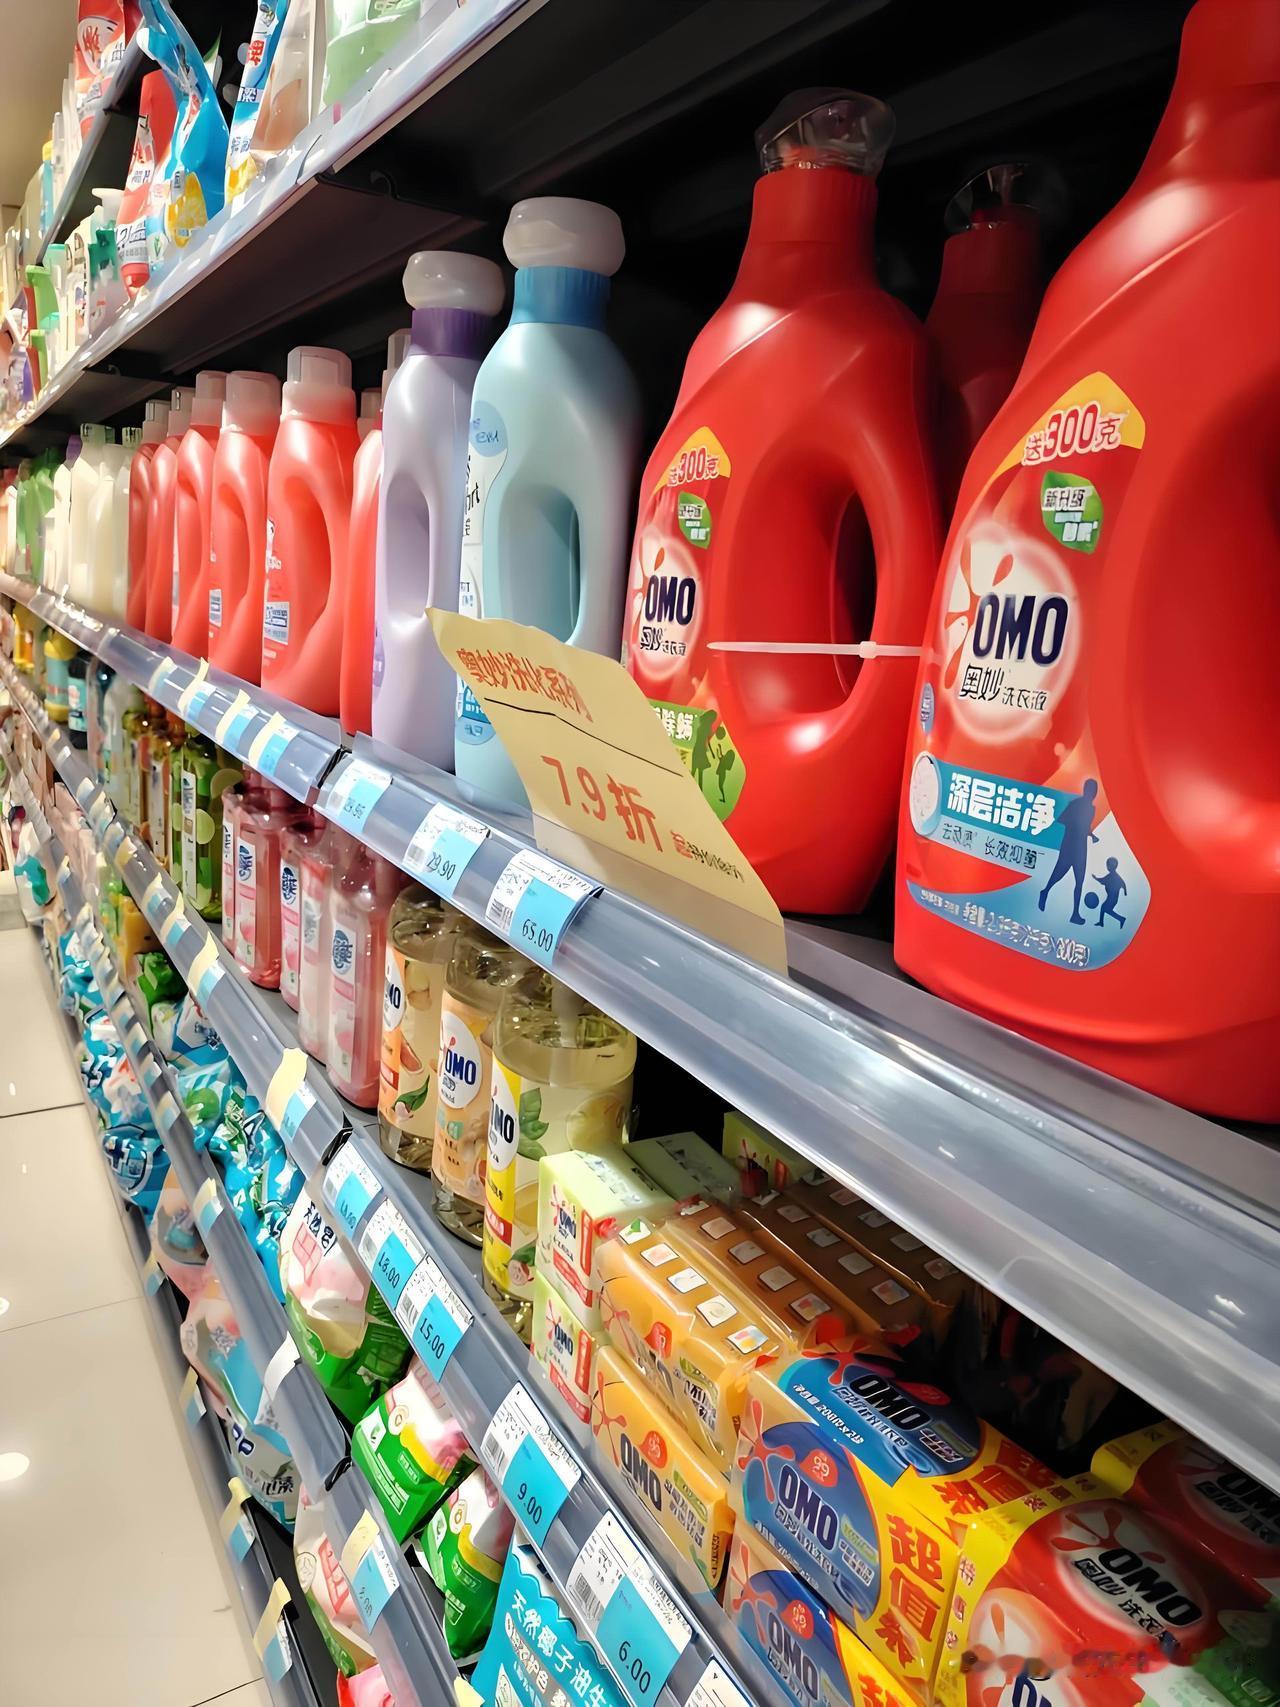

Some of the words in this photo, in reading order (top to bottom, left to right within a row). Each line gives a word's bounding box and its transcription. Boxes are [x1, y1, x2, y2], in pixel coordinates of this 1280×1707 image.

[644, 573, 697, 626] OMO
[972, 592, 1069, 667] OMO
[946, 772, 1057, 837] 深层洁净
[426, 851, 457, 881] 29.90
[521, 918, 554, 953] 65.00
[444, 1047, 477, 1086] OMO
[490, 1098, 516, 1144] MO
[419, 1317, 446, 1360] 15.00
[850, 1374, 932, 1431] OMO
[516, 1482, 543, 1525] 9.00
[778, 1463, 839, 1552] OMO
[1098, 1547, 1203, 1627] OMO
[1118, 1598, 1176, 1643] 洗衣
[618, 1640, 651, 1695] 6.00
[768, 1611, 819, 1701] OMO
